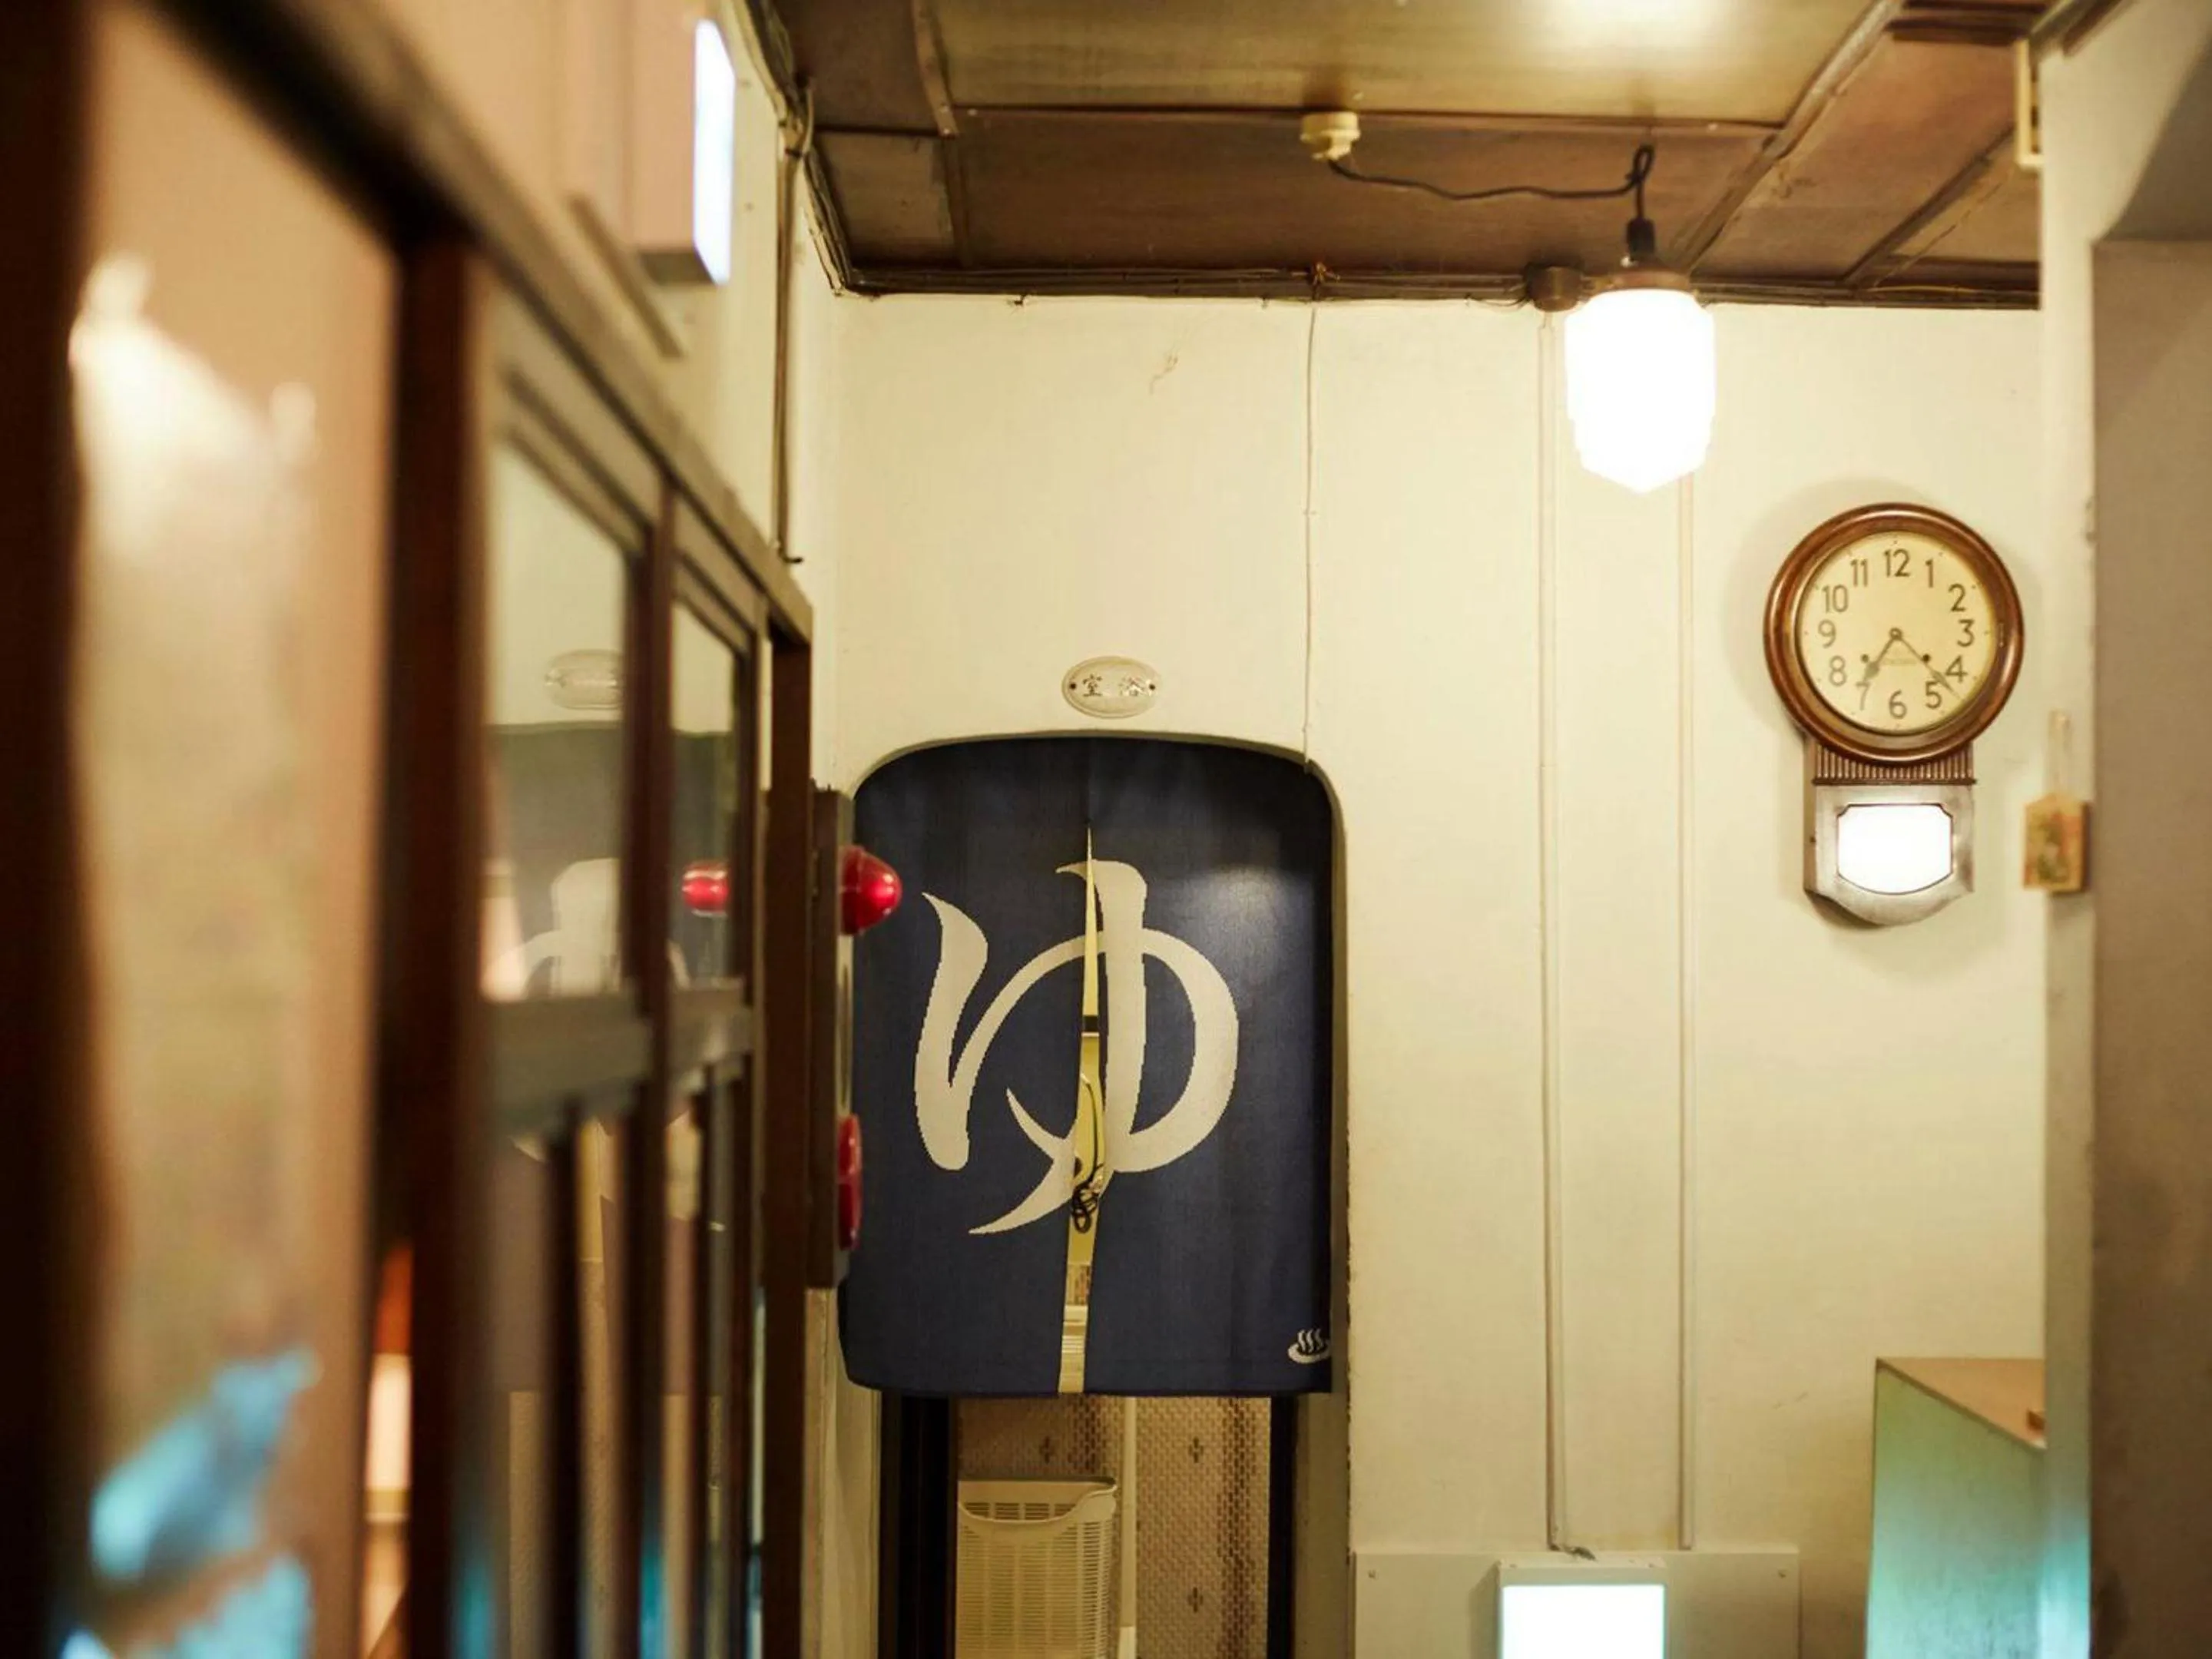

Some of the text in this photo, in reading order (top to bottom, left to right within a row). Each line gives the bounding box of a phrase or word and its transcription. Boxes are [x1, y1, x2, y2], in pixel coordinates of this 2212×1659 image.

[1850, 558, 1868, 588] 11
[1884, 548, 1910, 578] 12
[1925, 558, 1934, 588] 1
[1822, 584, 1849, 613] 10
[1949, 583, 1967, 612] 2
[1818, 619, 1836, 648] 9
[1958, 619, 1975, 647] 3
[1829, 655, 1846, 686] 8
[1945, 655, 1968, 683] 4
[1855, 680, 1872, 711] 7
[1888, 690, 1907, 719] 6
[1925, 680, 1942, 709] 5
[914, 859, 1239, 1234] ゆ
